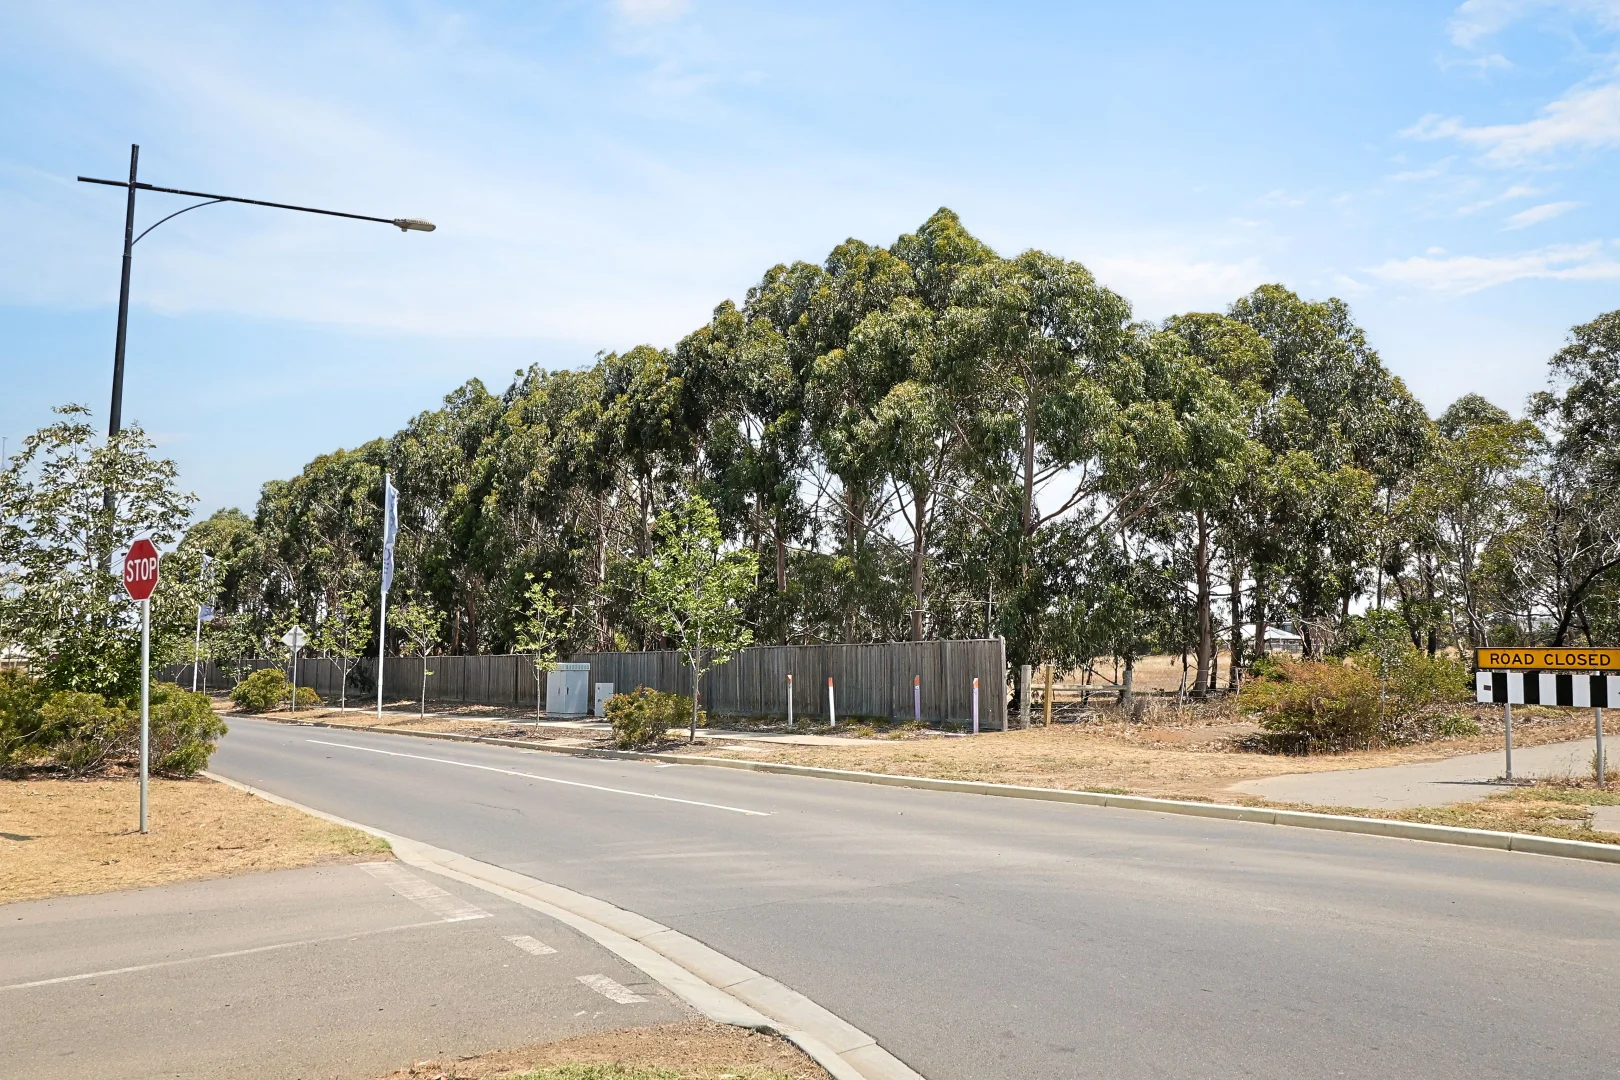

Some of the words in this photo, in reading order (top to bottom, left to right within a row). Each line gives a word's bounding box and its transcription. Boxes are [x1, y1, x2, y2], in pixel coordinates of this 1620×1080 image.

[126, 557, 157, 583] STOP
[1490, 653, 1534, 665] ROAD
[1544, 653, 1611, 666] CLOSED
